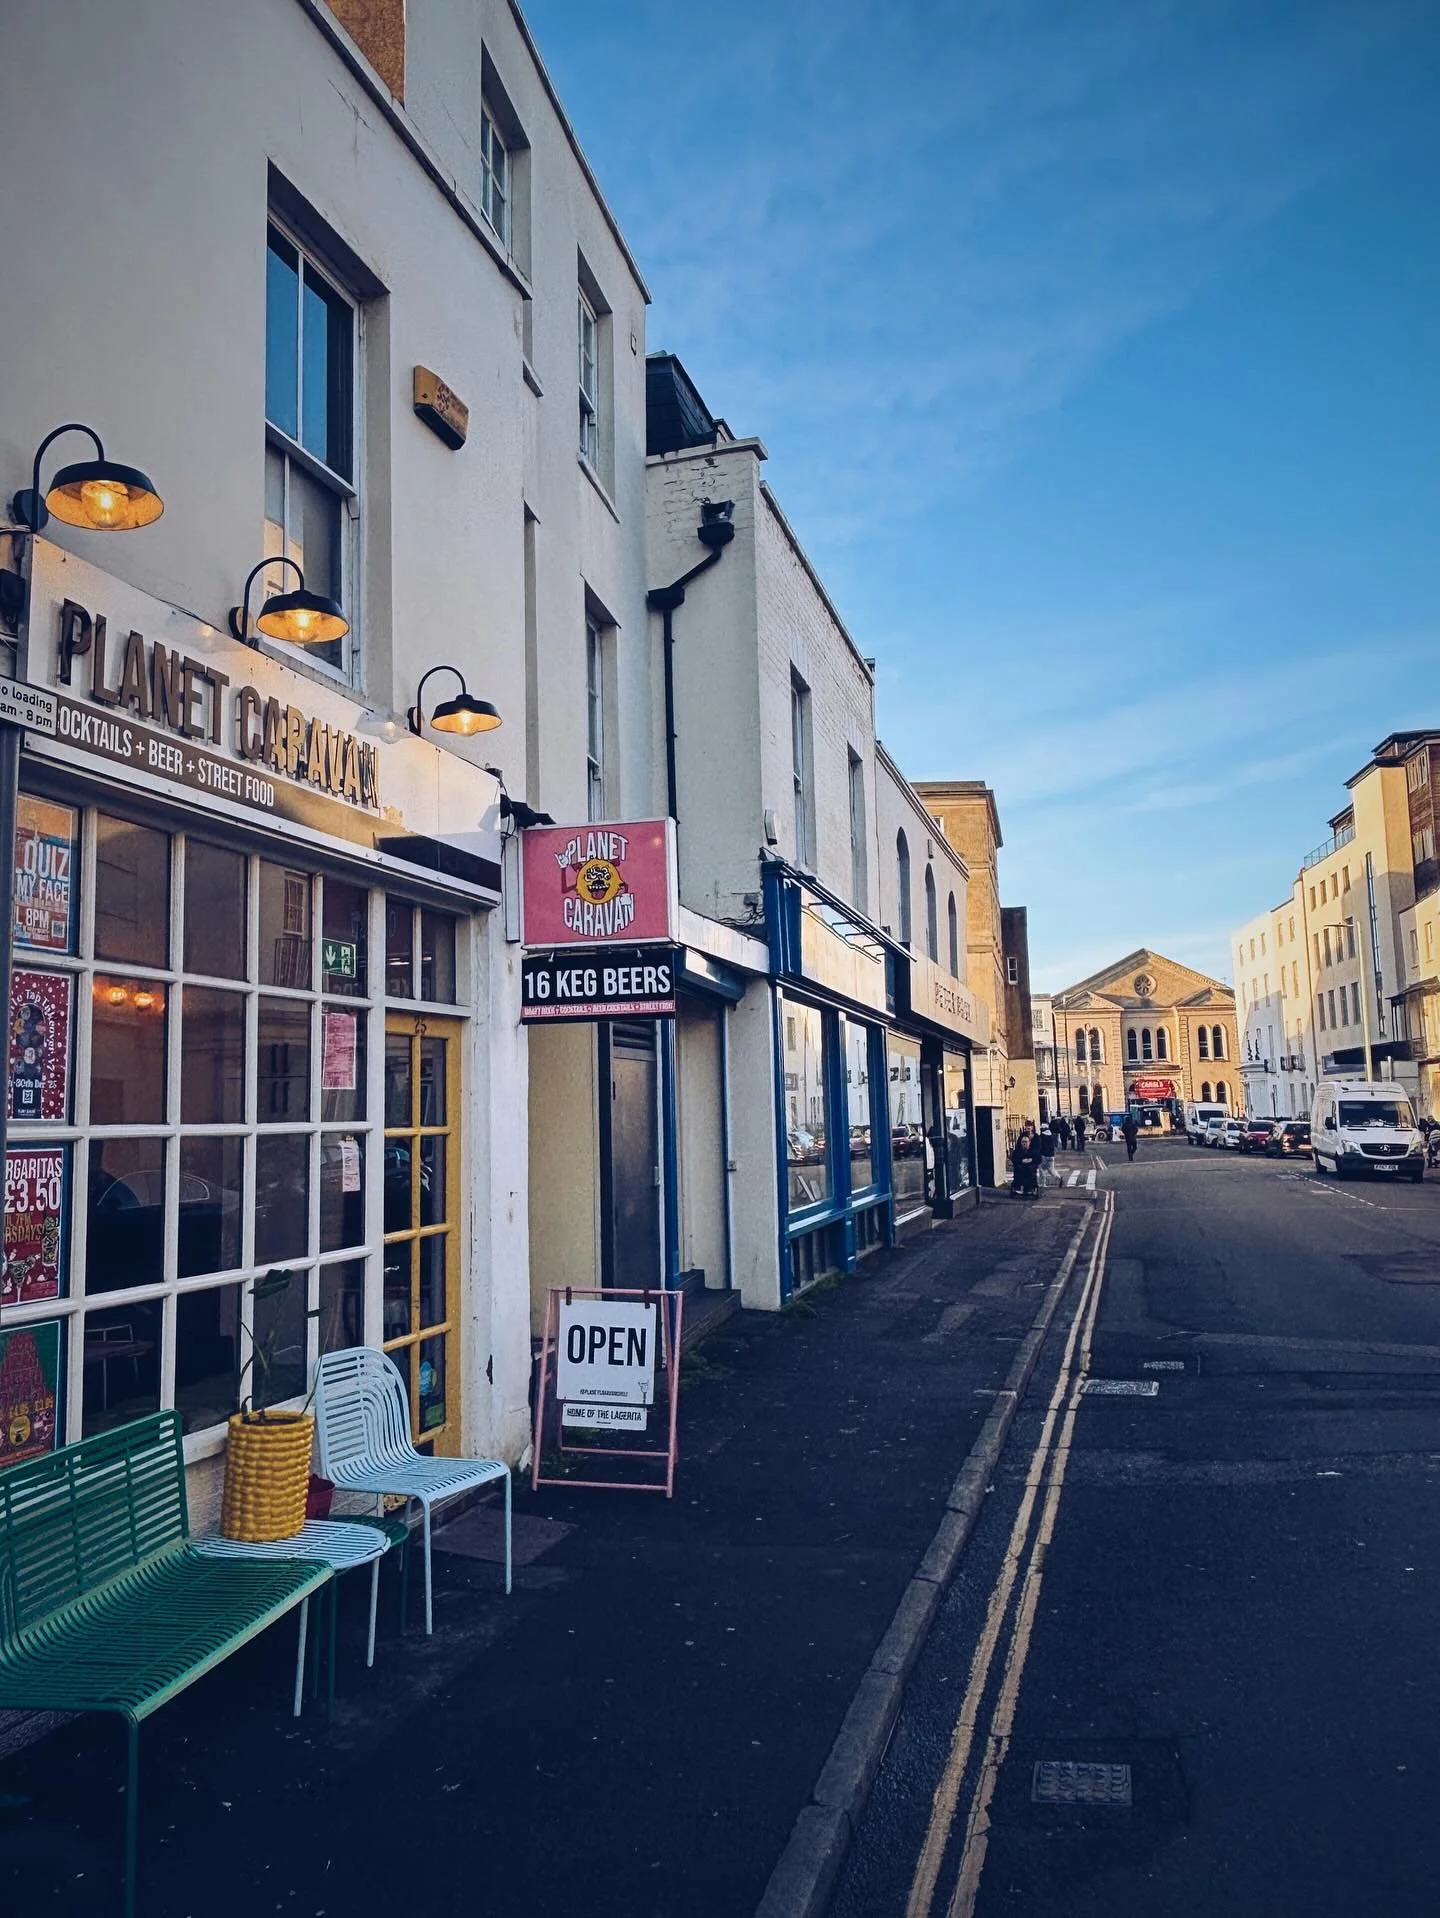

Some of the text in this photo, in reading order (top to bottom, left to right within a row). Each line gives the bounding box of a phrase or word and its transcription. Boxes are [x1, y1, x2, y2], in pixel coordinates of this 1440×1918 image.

[12, 686, 52, 713] loading
[60, 598, 380, 809] PLANET CARAVAN
[26, 709, 33, 721] 8
[36, 714, 52, 728] pm
[58, 705, 132, 757] OCKTAILS
[148, 739, 183, 775] BEER
[198, 757, 244, 796] STREET
[245, 775, 274, 807] FOOD
[24, 838, 69, 881] QUIZ
[566, 831, 629, 864] PLANET
[39, 879, 69, 905] FACE
[26, 908, 49, 930] 8PM
[562, 893, 635, 937] CARAVAN
[525, 965, 671, 998] 16 KEG BEERS
[5, 1157, 63, 1180] RGARITAS
[4, 1177, 61, 1213] £3.50
[5, 1224, 42, 1243] RSDAYS
[567, 1324, 647, 1367] OPEN
[567, 1407, 642, 1421] HOME OF THE LAGERITA
